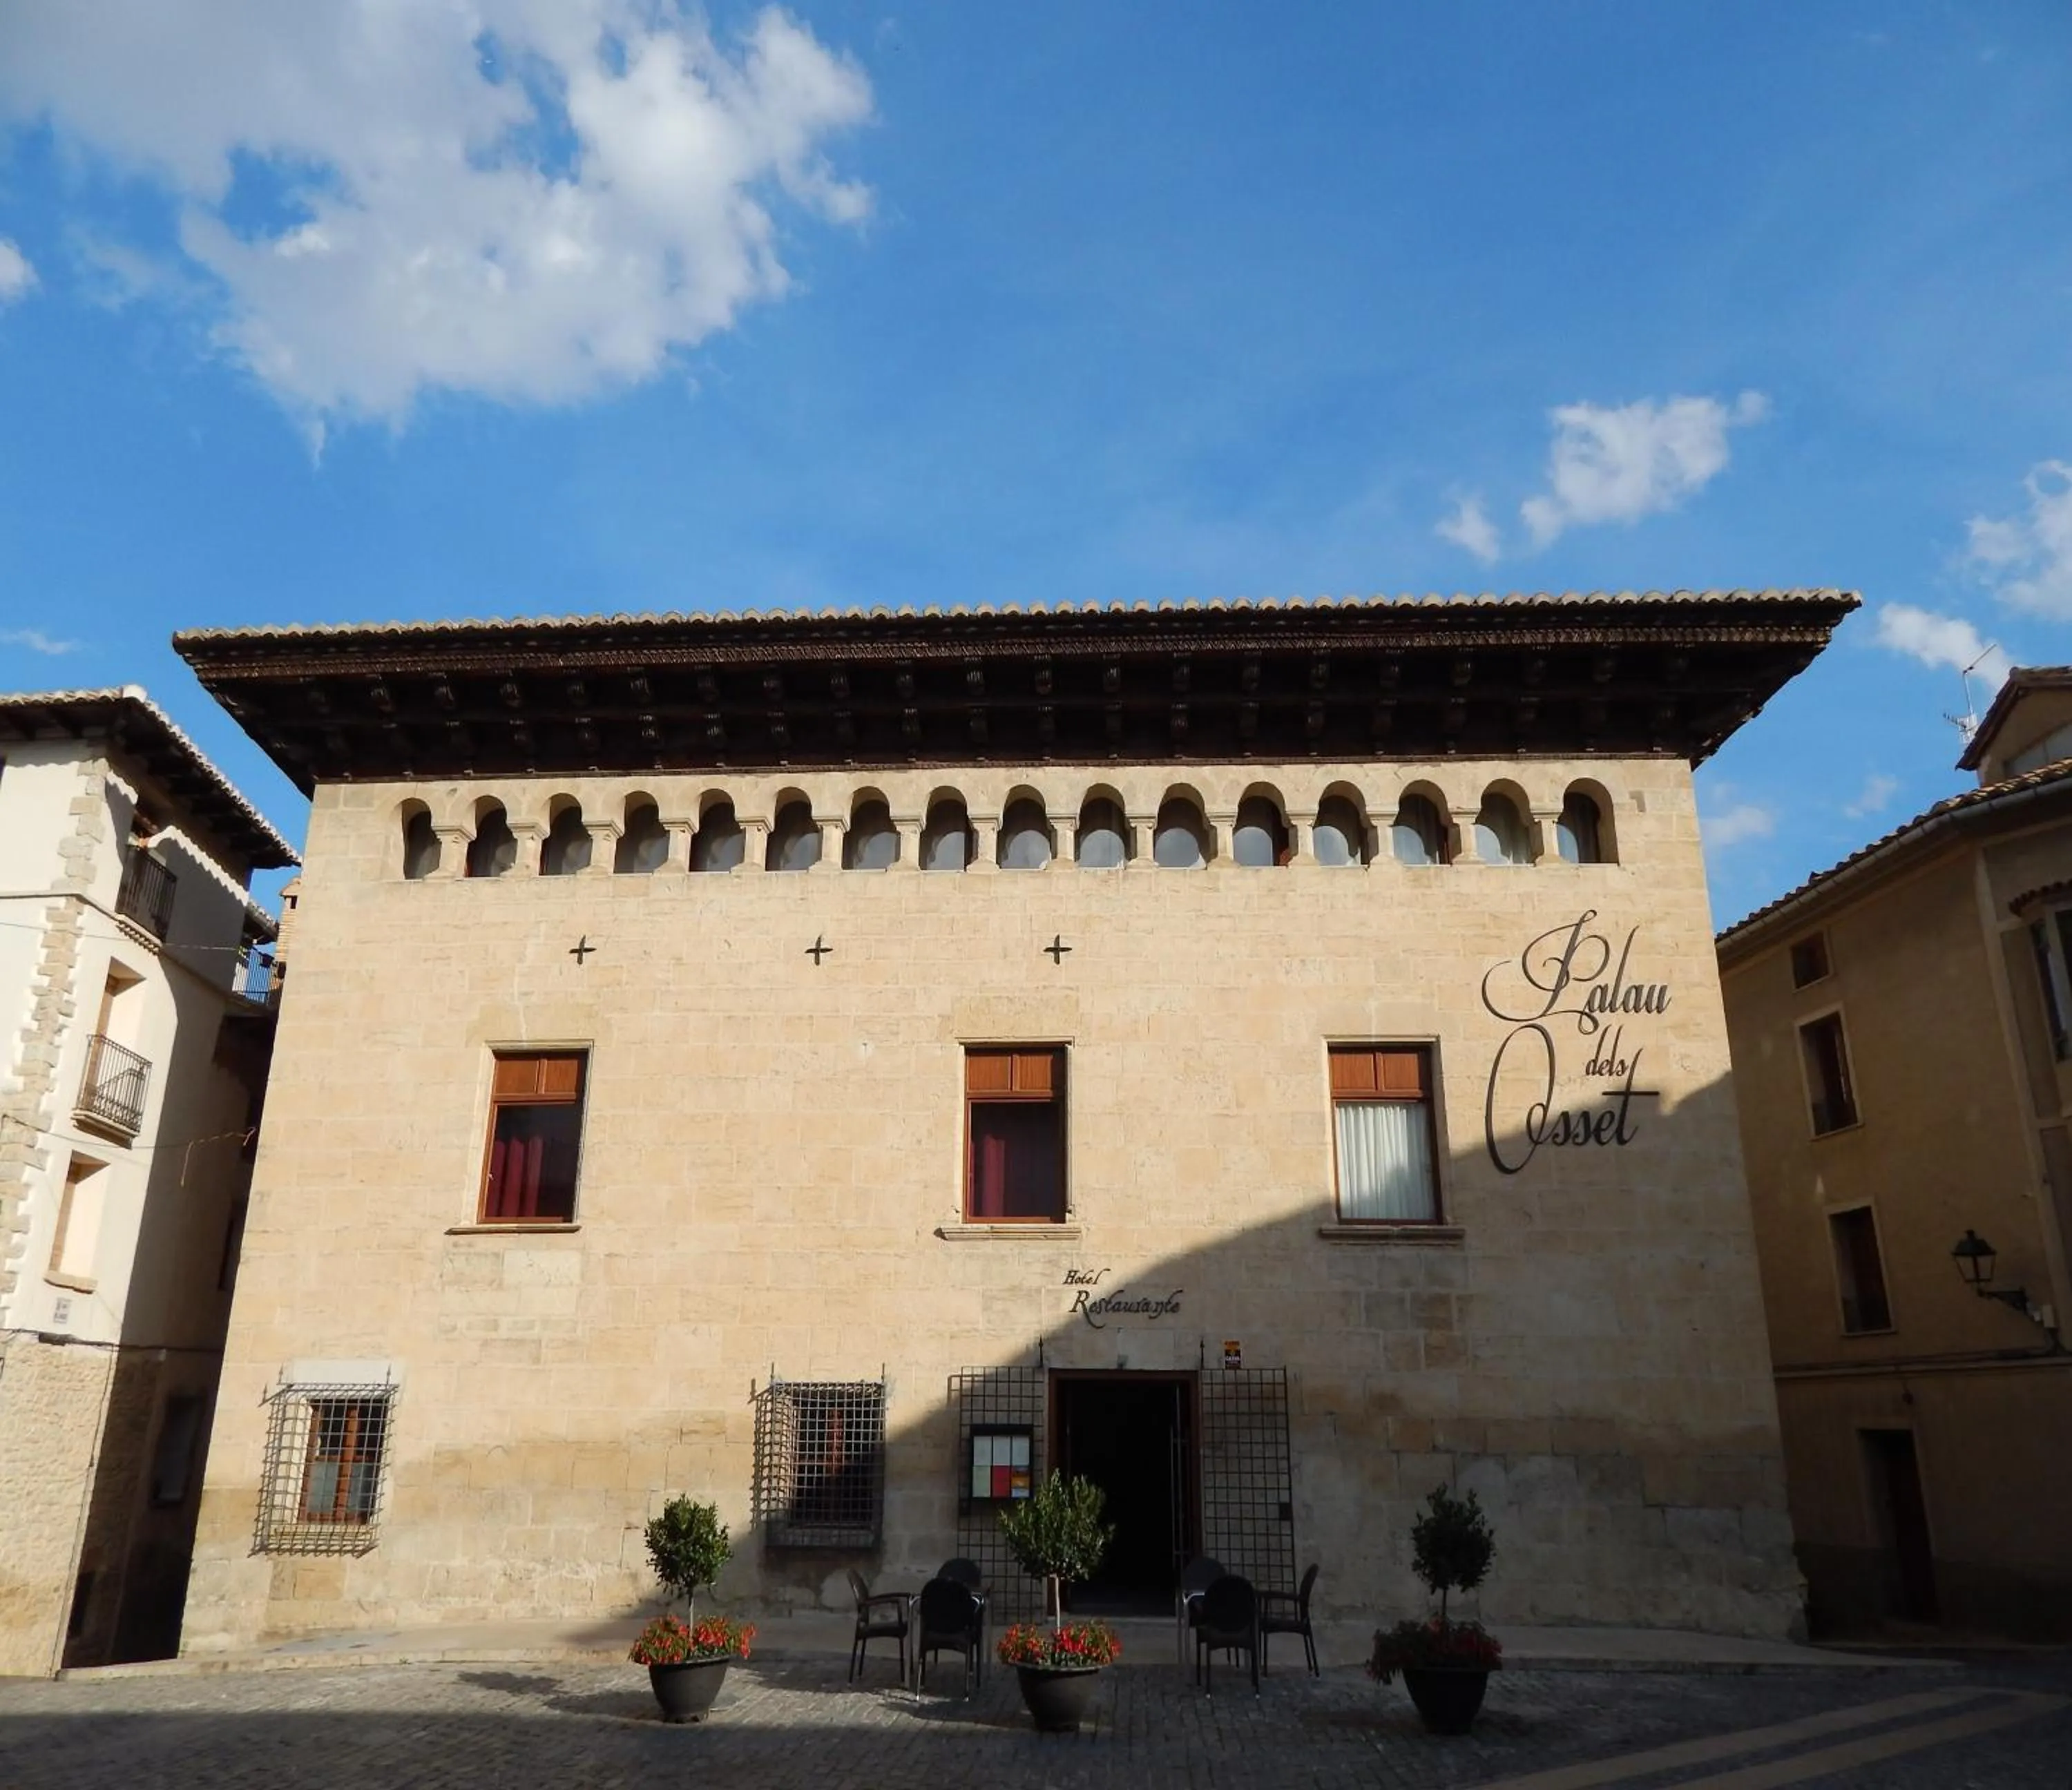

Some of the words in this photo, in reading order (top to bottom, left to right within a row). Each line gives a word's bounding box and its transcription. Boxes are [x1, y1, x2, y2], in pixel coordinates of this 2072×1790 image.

[1481, 909, 1671, 1035] Palau
[1585, 1023, 1629, 1077] dels
[1485, 1023, 1660, 1174] Osset
[1062, 1269, 1111, 1285] Hotel
[1068, 1289, 1183, 1329] Restaurante
